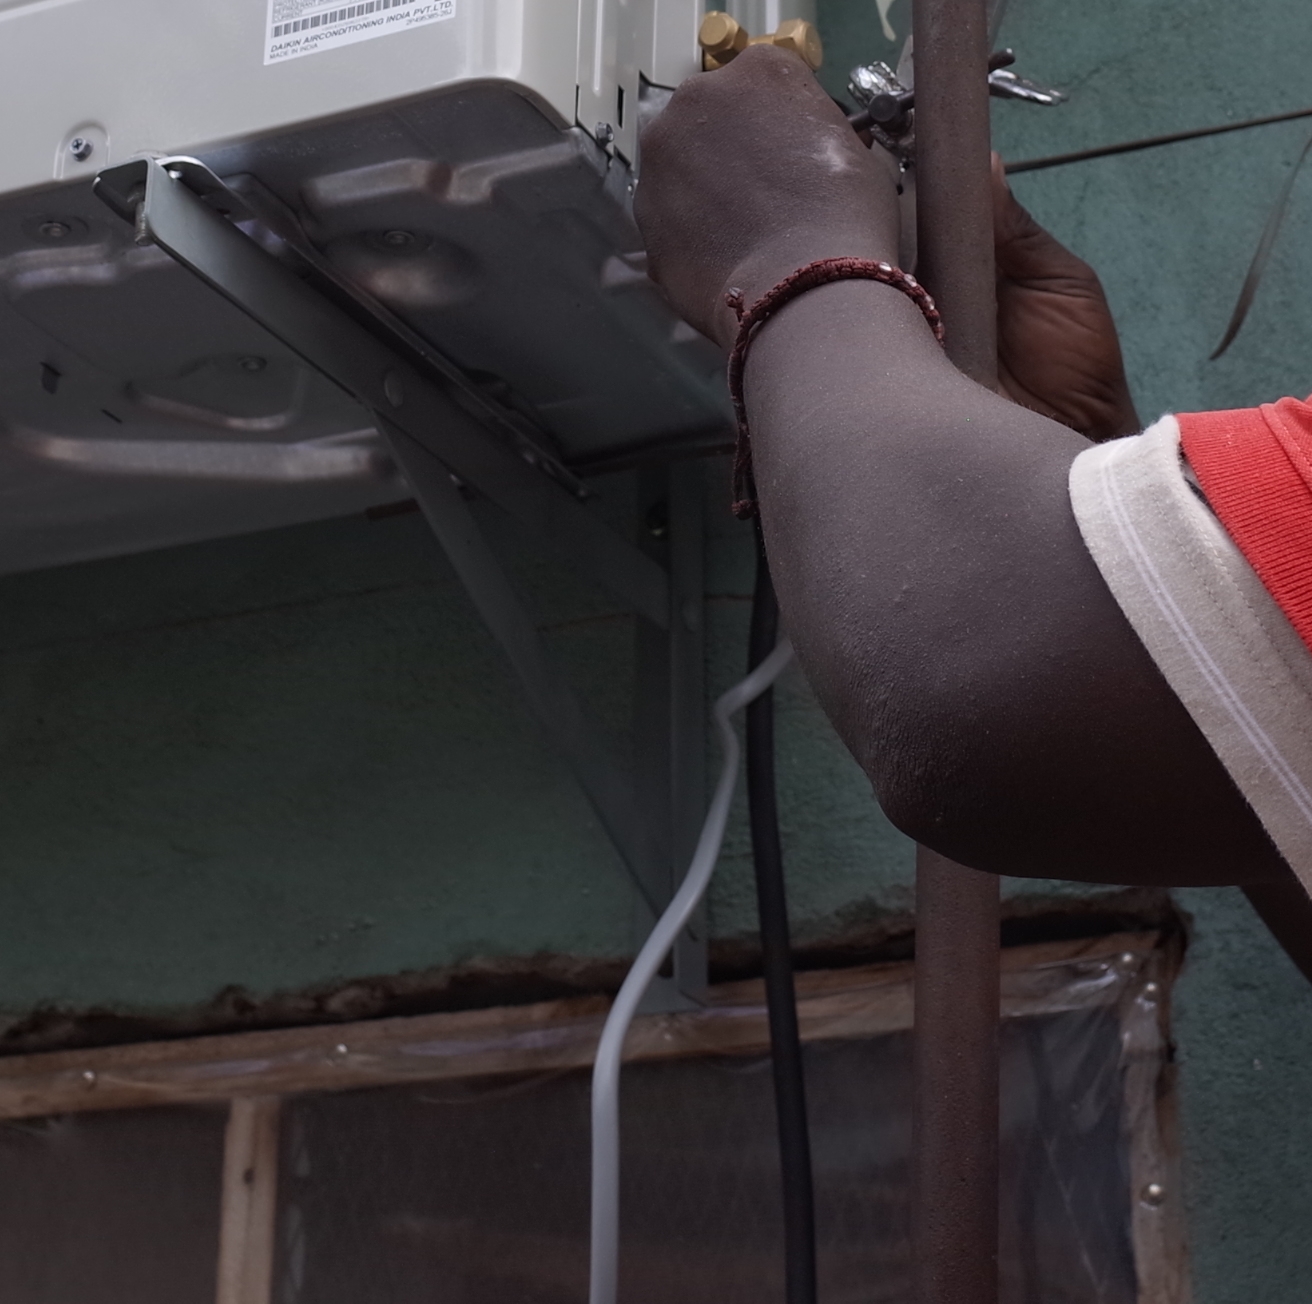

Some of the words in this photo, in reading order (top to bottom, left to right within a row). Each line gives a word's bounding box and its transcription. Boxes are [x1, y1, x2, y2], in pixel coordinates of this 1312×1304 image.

[270, 37, 301, 52] DAIKIN
[302, 16, 384, 44] AIRCONDITIONING
[385, 10, 410, 23] INDIA
[269, 49, 288, 60] MADE
[299, 42, 318, 52] INDIA
